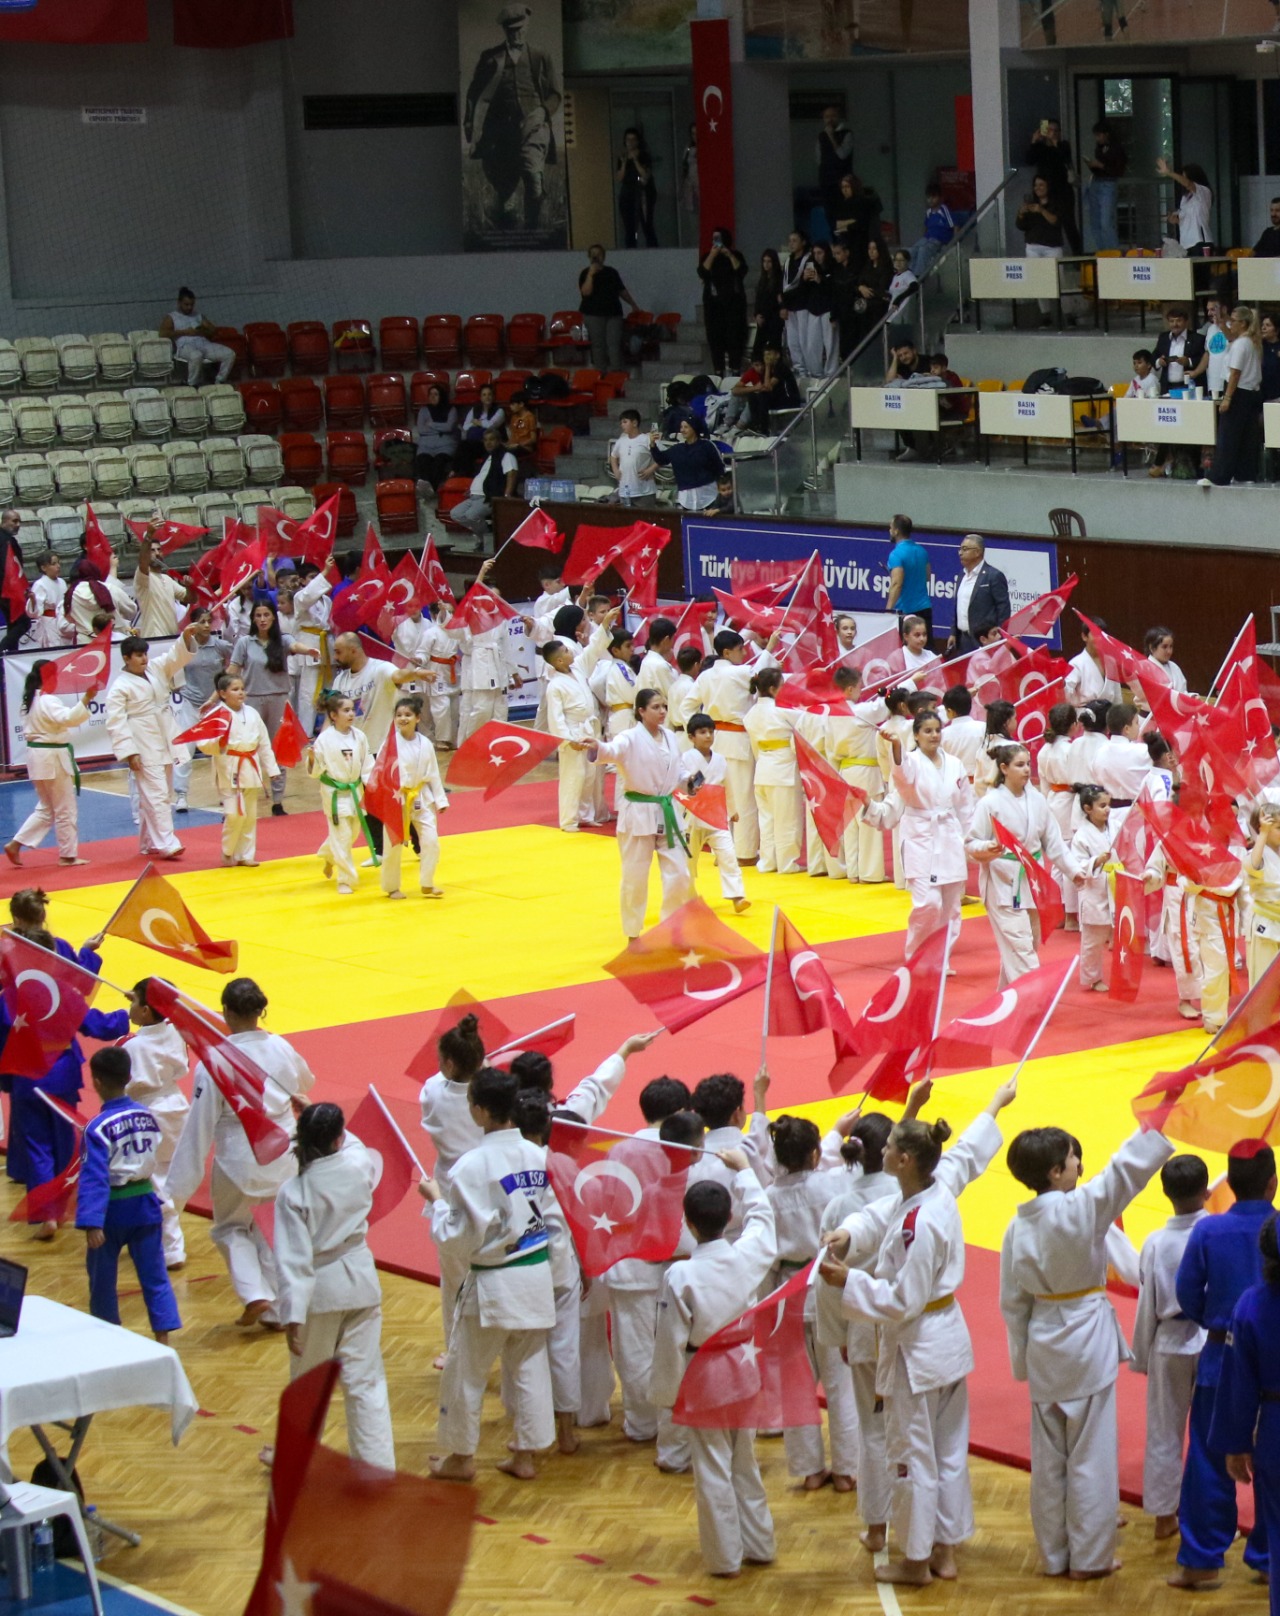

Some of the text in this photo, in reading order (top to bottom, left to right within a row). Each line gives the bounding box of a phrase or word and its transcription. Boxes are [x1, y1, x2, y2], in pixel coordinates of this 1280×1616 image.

[1132, 265, 1151, 273] BASIN
[1006, 272, 1023, 280] PRESS
[1132, 273, 1151, 281] PRESS
[1017, 400, 1035, 408] BASIN
[1158, 415, 1177, 423] PRESS
[1008, 590, 1042, 602] YÜKŞEHİR
[122, 1138, 153, 1156] TUR
